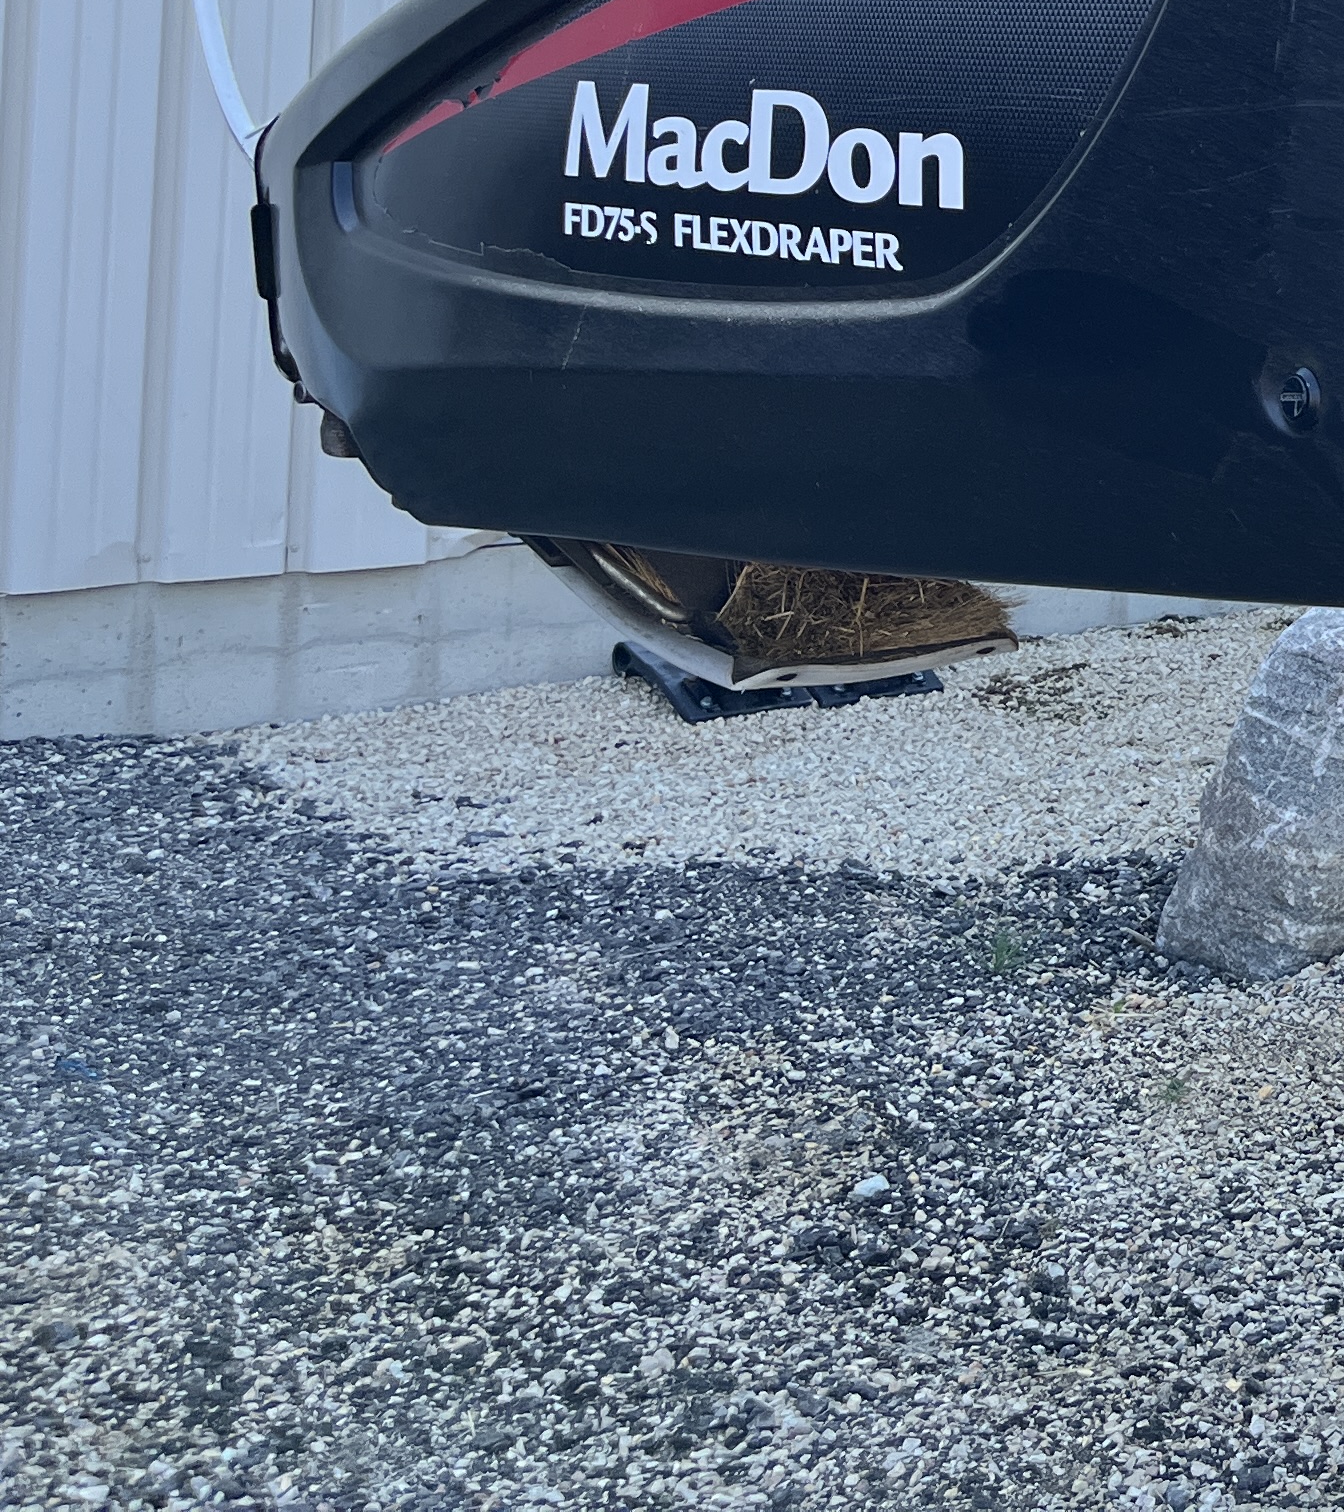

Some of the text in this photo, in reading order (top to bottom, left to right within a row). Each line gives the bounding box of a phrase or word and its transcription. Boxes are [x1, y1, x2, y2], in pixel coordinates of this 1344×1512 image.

[563, 80, 965, 210] MacDon
[563, 201, 904, 271] FD75-S FLEXDRAPER
